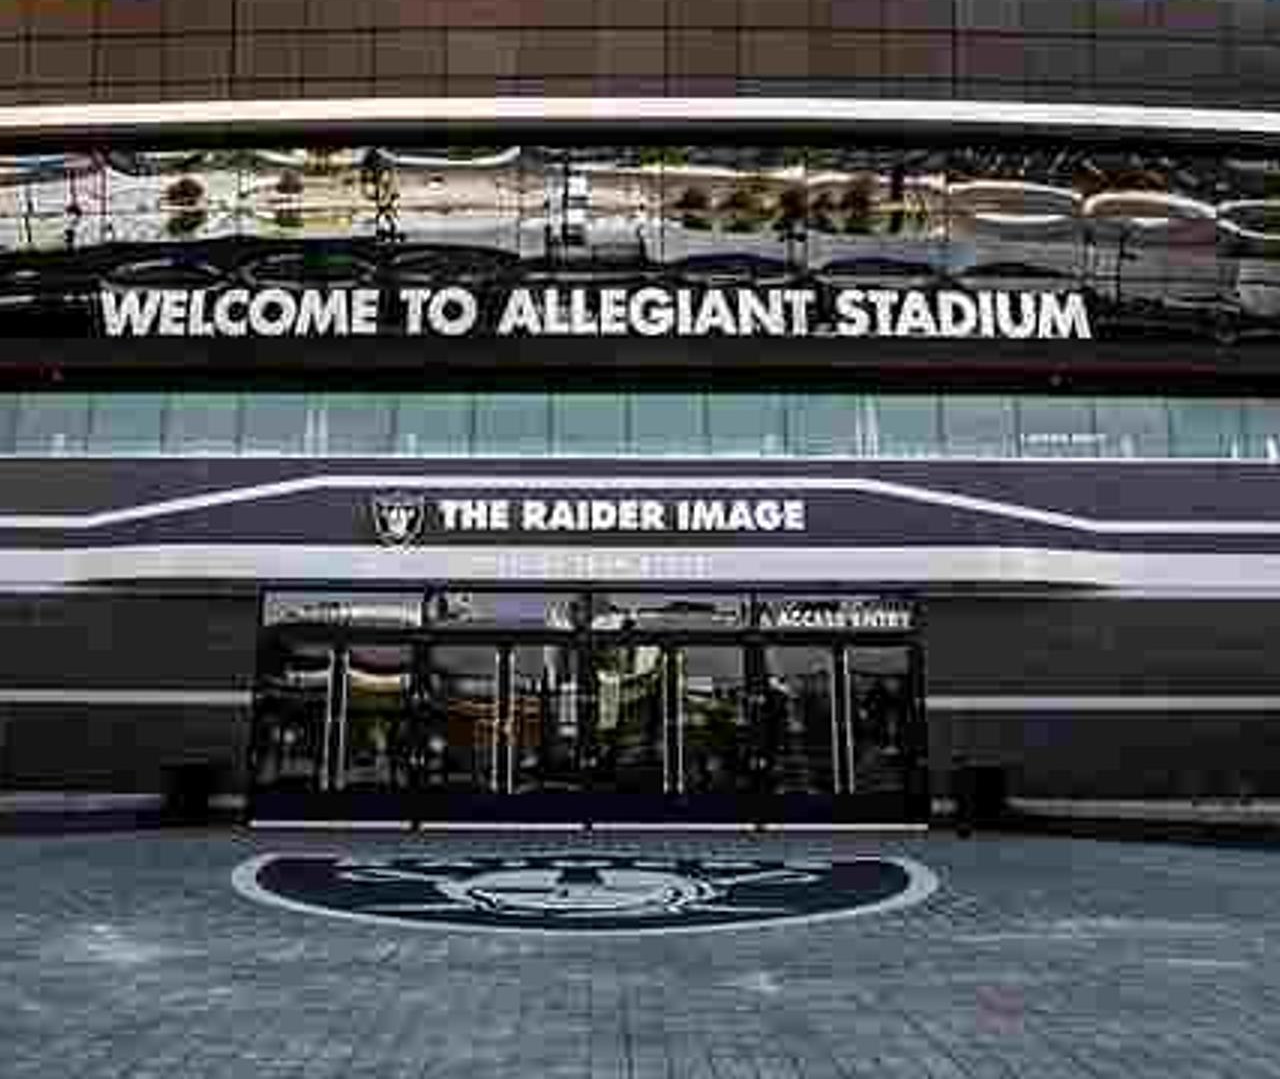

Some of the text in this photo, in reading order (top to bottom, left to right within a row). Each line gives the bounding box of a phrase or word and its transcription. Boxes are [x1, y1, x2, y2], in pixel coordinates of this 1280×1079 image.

[100, 286, 1093, 339] WELCOME TO ALLEGIANT STADIUM
[437, 499, 806, 531] THE RAIDER IMAGE
